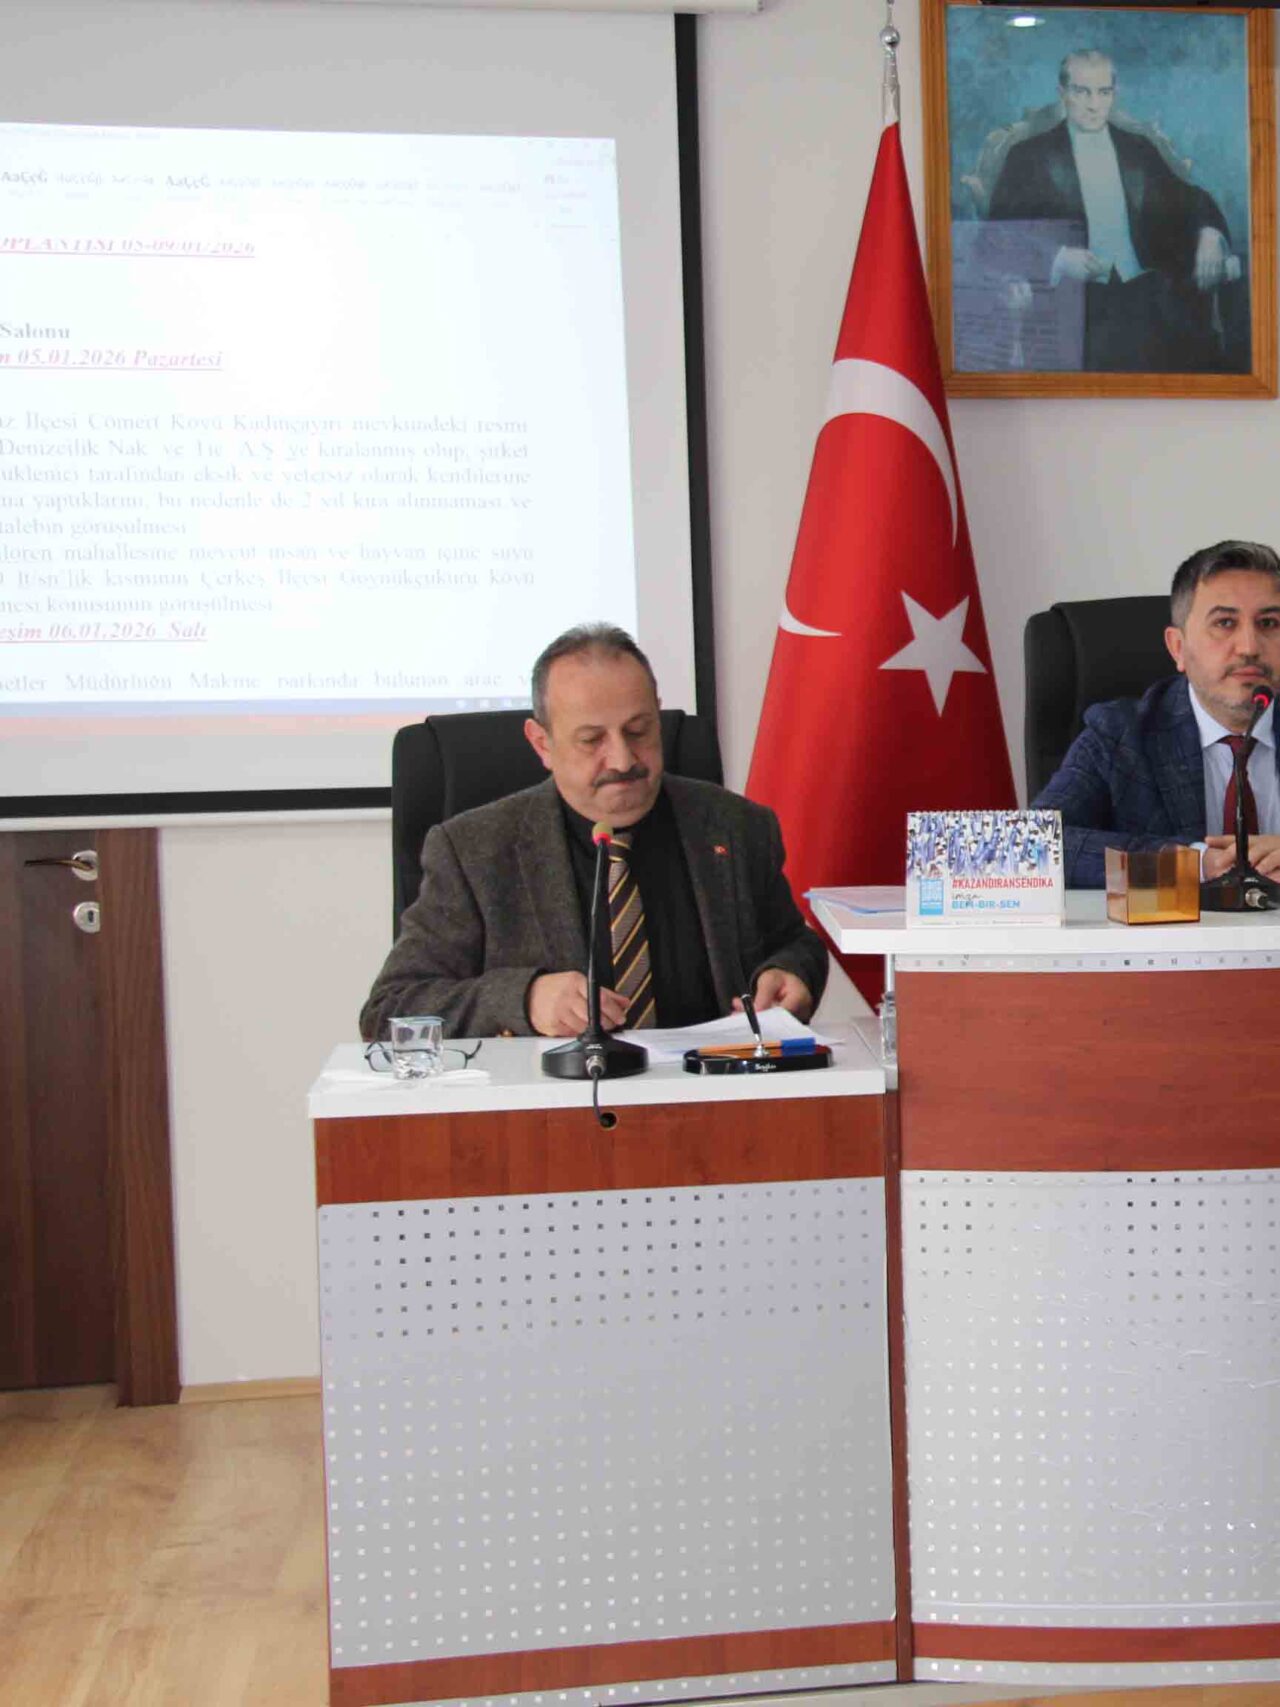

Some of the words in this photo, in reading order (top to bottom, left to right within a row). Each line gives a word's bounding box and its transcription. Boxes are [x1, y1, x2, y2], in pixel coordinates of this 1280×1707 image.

[0, 322, 71, 341] Salonu
[17, 348, 128, 367] 05.01.2026
[133, 350, 222, 369] Pazartesi
[250, 469, 273, 483] ve
[48, 621, 157, 640] 06.01.2026
[168, 621, 208, 640] Salı
